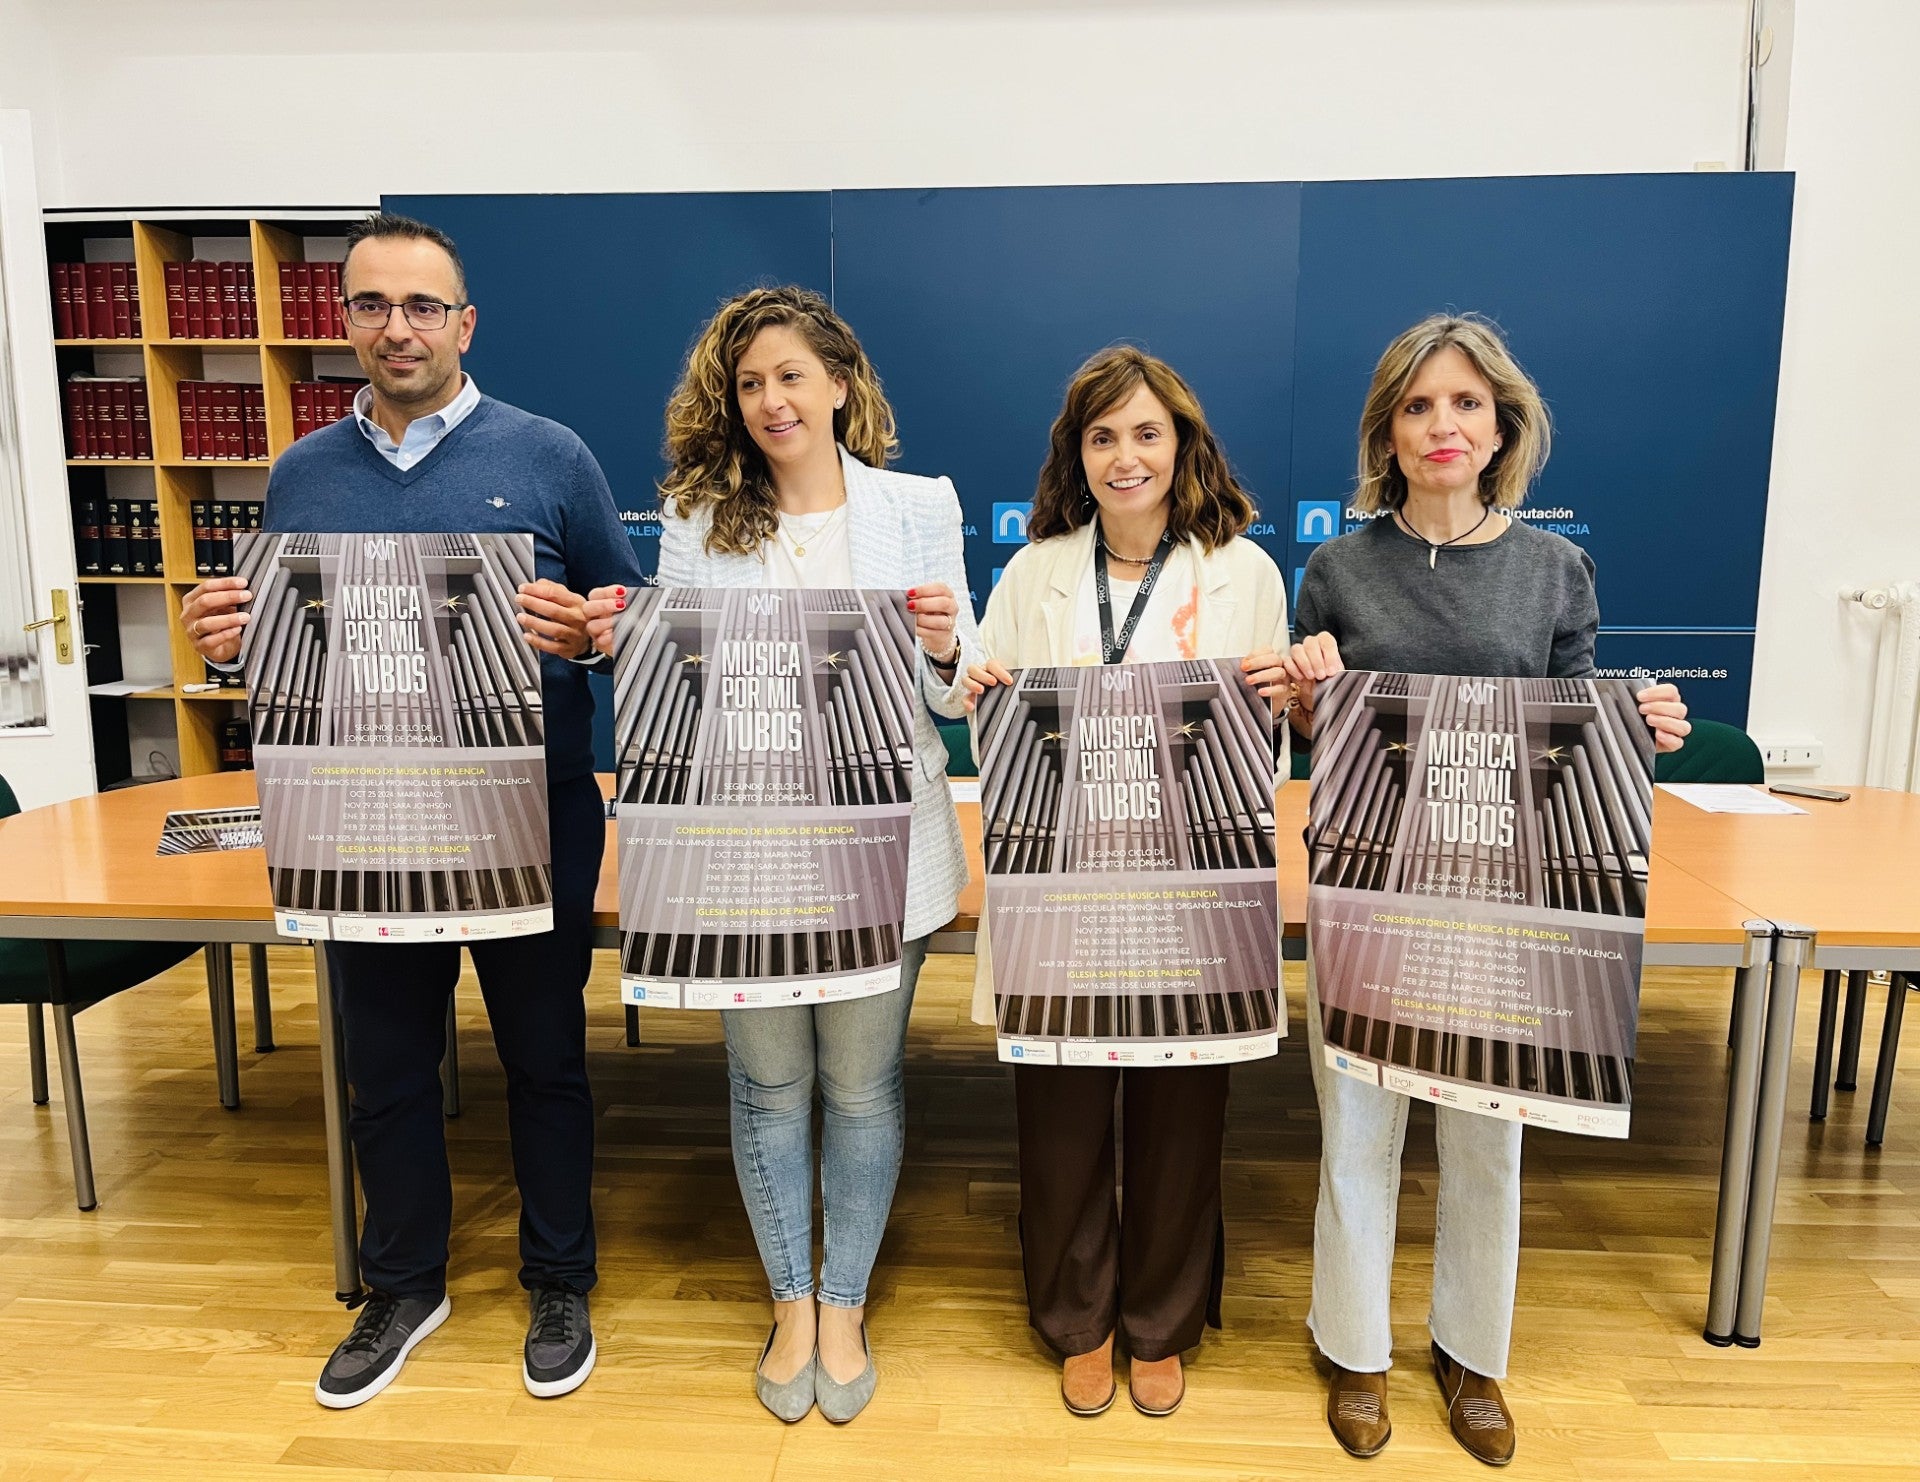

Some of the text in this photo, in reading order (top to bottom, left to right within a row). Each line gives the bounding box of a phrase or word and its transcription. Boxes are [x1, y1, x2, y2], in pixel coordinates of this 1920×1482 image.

[619, 510, 661, 520] utació
[1097, 568, 1106, 603] PROSOL
[1139, 561, 1159, 594] PROSOL
[342, 578, 422, 620] MÚSICA
[345, 621, 424, 652] POR MIL
[1116, 615, 1137, 649] PROSOL
[722, 633, 801, 676] MÚSICA
[348, 654, 427, 694] TUBOS
[1596, 666, 1728, 680] www.dip-palencia.es
[722, 677, 801, 708] POR MIL
[355, 724, 432, 732] SEGUNDO CICLO DE
[722, 711, 802, 752] TUBOS
[1079, 709, 1157, 750] MÚSICA
[407, 734, 442, 742] ÓRGANO
[1428, 722, 1516, 770] MÚSICA
[312, 766, 485, 775] CONSERVATORIO DE MÚSICA DE PALENCIA
[1081, 749, 1159, 782] POR MIL
[1427, 767, 1515, 804] POR MIL
[777, 792, 814, 801] ÓRGANO
[1083, 781, 1162, 822] TUBOS
[676, 827, 747, 835] CONSERVATORIO
[765, 826, 797, 835] MÚSICA
[800, 827, 811, 835] DE
[814, 826, 855, 834] PALENCIA
[1427, 801, 1515, 848] TUBOS
[433, 834, 463, 842] THIERRY
[627, 837, 644, 845] SEPT
[676, 838, 714, 846] ALUMNOS
[753, 838, 798, 846] PROVINCIAL
[800, 837, 810, 845] DE
[849, 836, 860, 844] DE
[862, 835, 896, 843] PALENCIA
[1088, 850, 1126, 858] SEGUNDO
[1129, 849, 1152, 857] CICLO
[757, 862, 778, 870] SARA
[781, 862, 818, 870] JONHSON
[1076, 860, 1124, 868] CONCIERTOS
[1139, 857, 1175, 867] ÓRGANO
[1427, 873, 1513, 887] SEGUNDO CICLO DE
[1044, 890, 1217, 901] CONSERVATORIO DE MÚSICA DE PALENCIA
[1413, 883, 1525, 899] CONCIERTOS DE ÓRGANO
[751, 907, 777, 915] PABLO
[780, 907, 791, 915] DE
[793, 905, 834, 914] PALENCIA
[1082, 915, 1098, 923] OCT
[1099, 915, 1107, 923] 25
[1155, 914, 1176, 922] NACY
[1373, 914, 1570, 940] CONSERVATORIO DE MÚSICA DE PALENCIA
[1067, 970, 1098, 978] IGLESIA
[1100, 970, 1116, 978] SAN
[1148, 969, 1160, 977] DE
[1161, 969, 1201, 977] PALENCIA
[1402, 965, 1419, 975] ENE
[1421, 968, 1430, 976] 30
[1453, 971, 1487, 982] ATSUKO
[1489, 975, 1525, 987] TAKANO
[1141, 981, 1156, 989] LUIS
[1402, 977, 1417, 987] FEB
[1420, 979, 1428, 988] 27
[1451, 983, 1486, 994] MARCEL
[1392, 999, 1542, 1025] IGLESIA SAN PABLO DE PALENCIA
